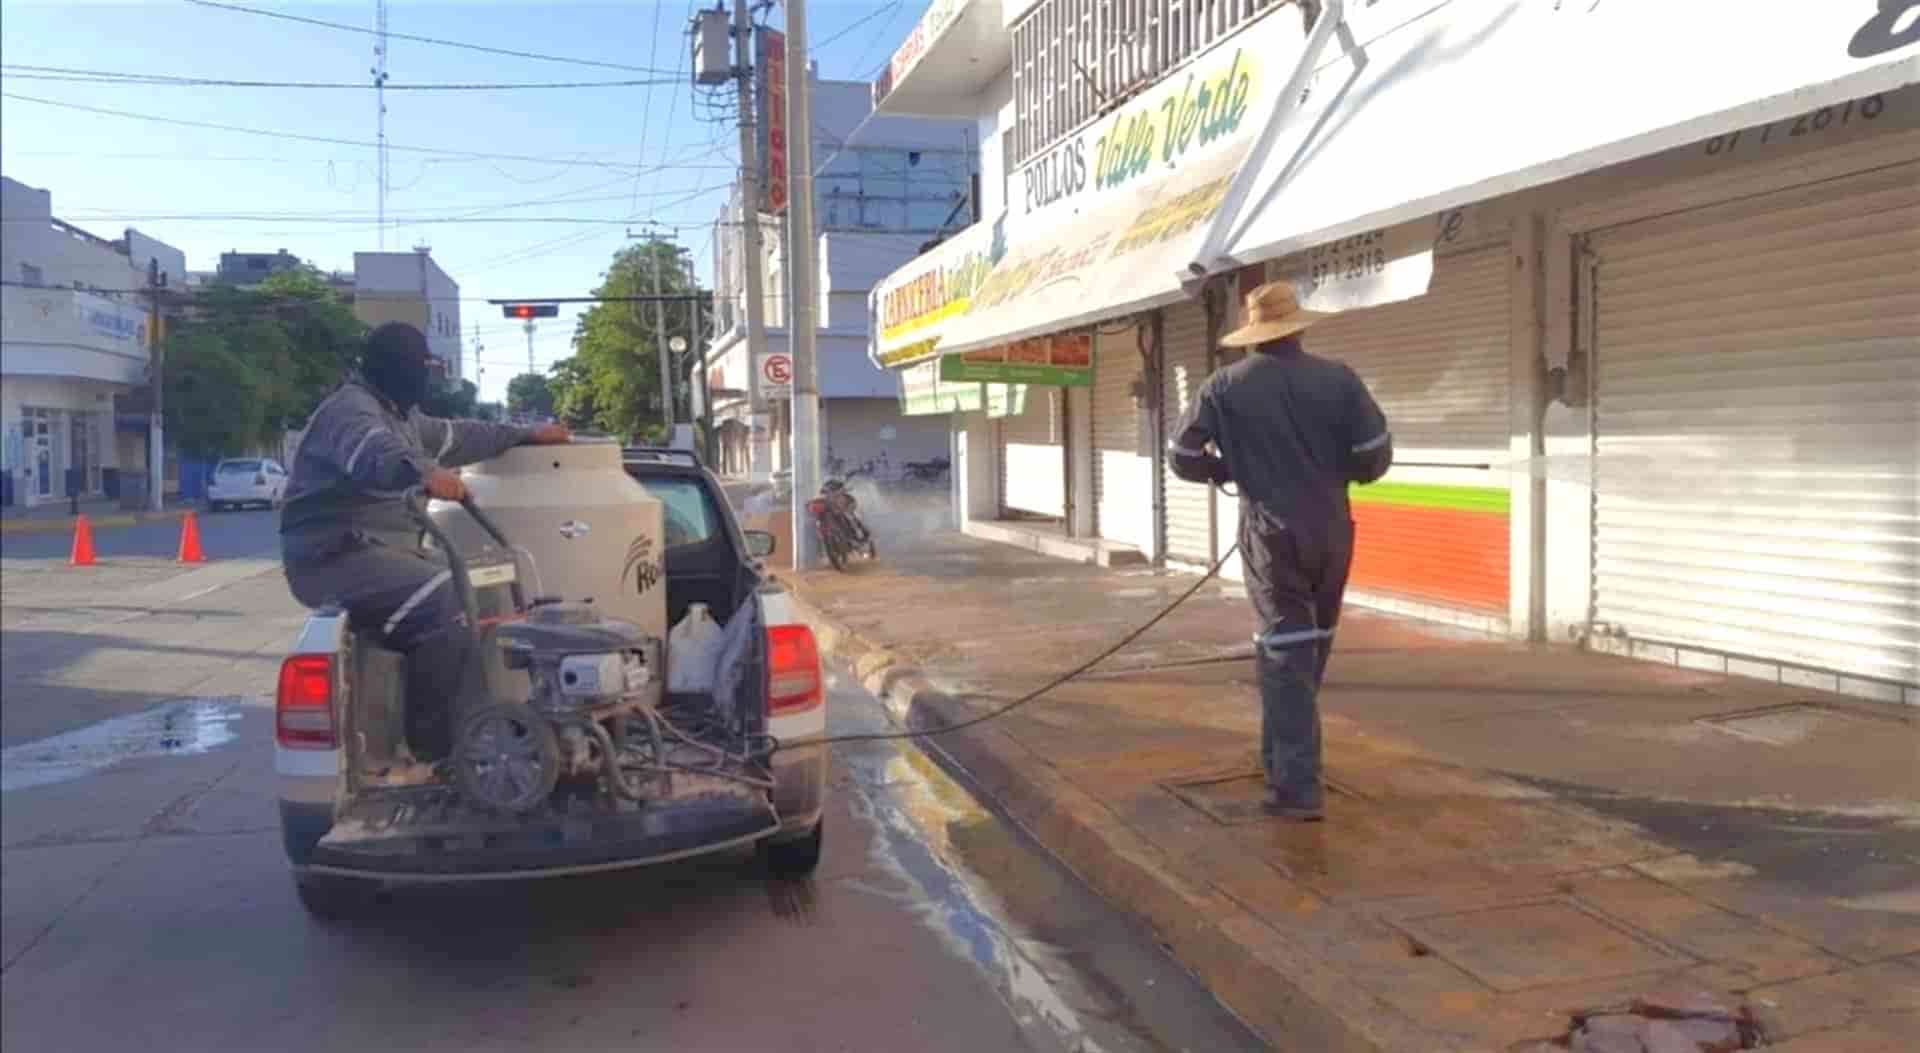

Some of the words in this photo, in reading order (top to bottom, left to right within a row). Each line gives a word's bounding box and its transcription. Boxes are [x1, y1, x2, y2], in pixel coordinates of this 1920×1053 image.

[1024, 136, 1087, 215] POLLOS
[1095, 113, 1155, 191] Valle
[1162, 47, 1249, 162] Verde
